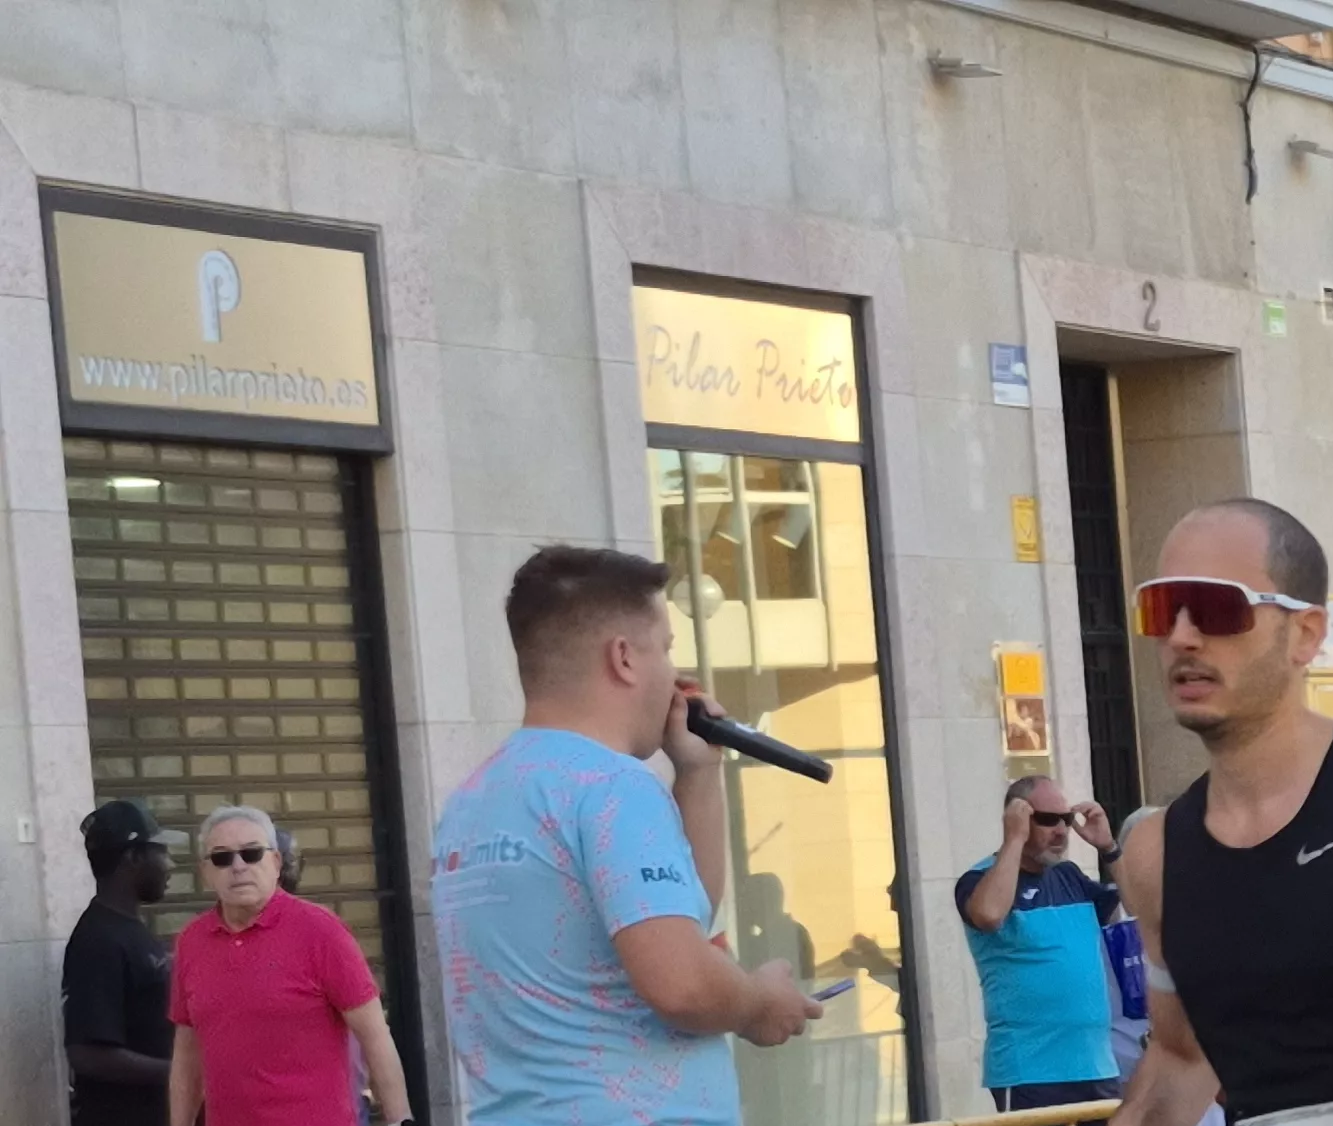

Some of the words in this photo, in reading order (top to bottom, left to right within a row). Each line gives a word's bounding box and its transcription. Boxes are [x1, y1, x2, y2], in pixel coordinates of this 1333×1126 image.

[1142, 281, 1161, 333] 2
[79, 354, 367, 409] www.pilarprieto.es
[645, 324, 742, 397] Pilar
[755, 338, 857, 408] Prieto
